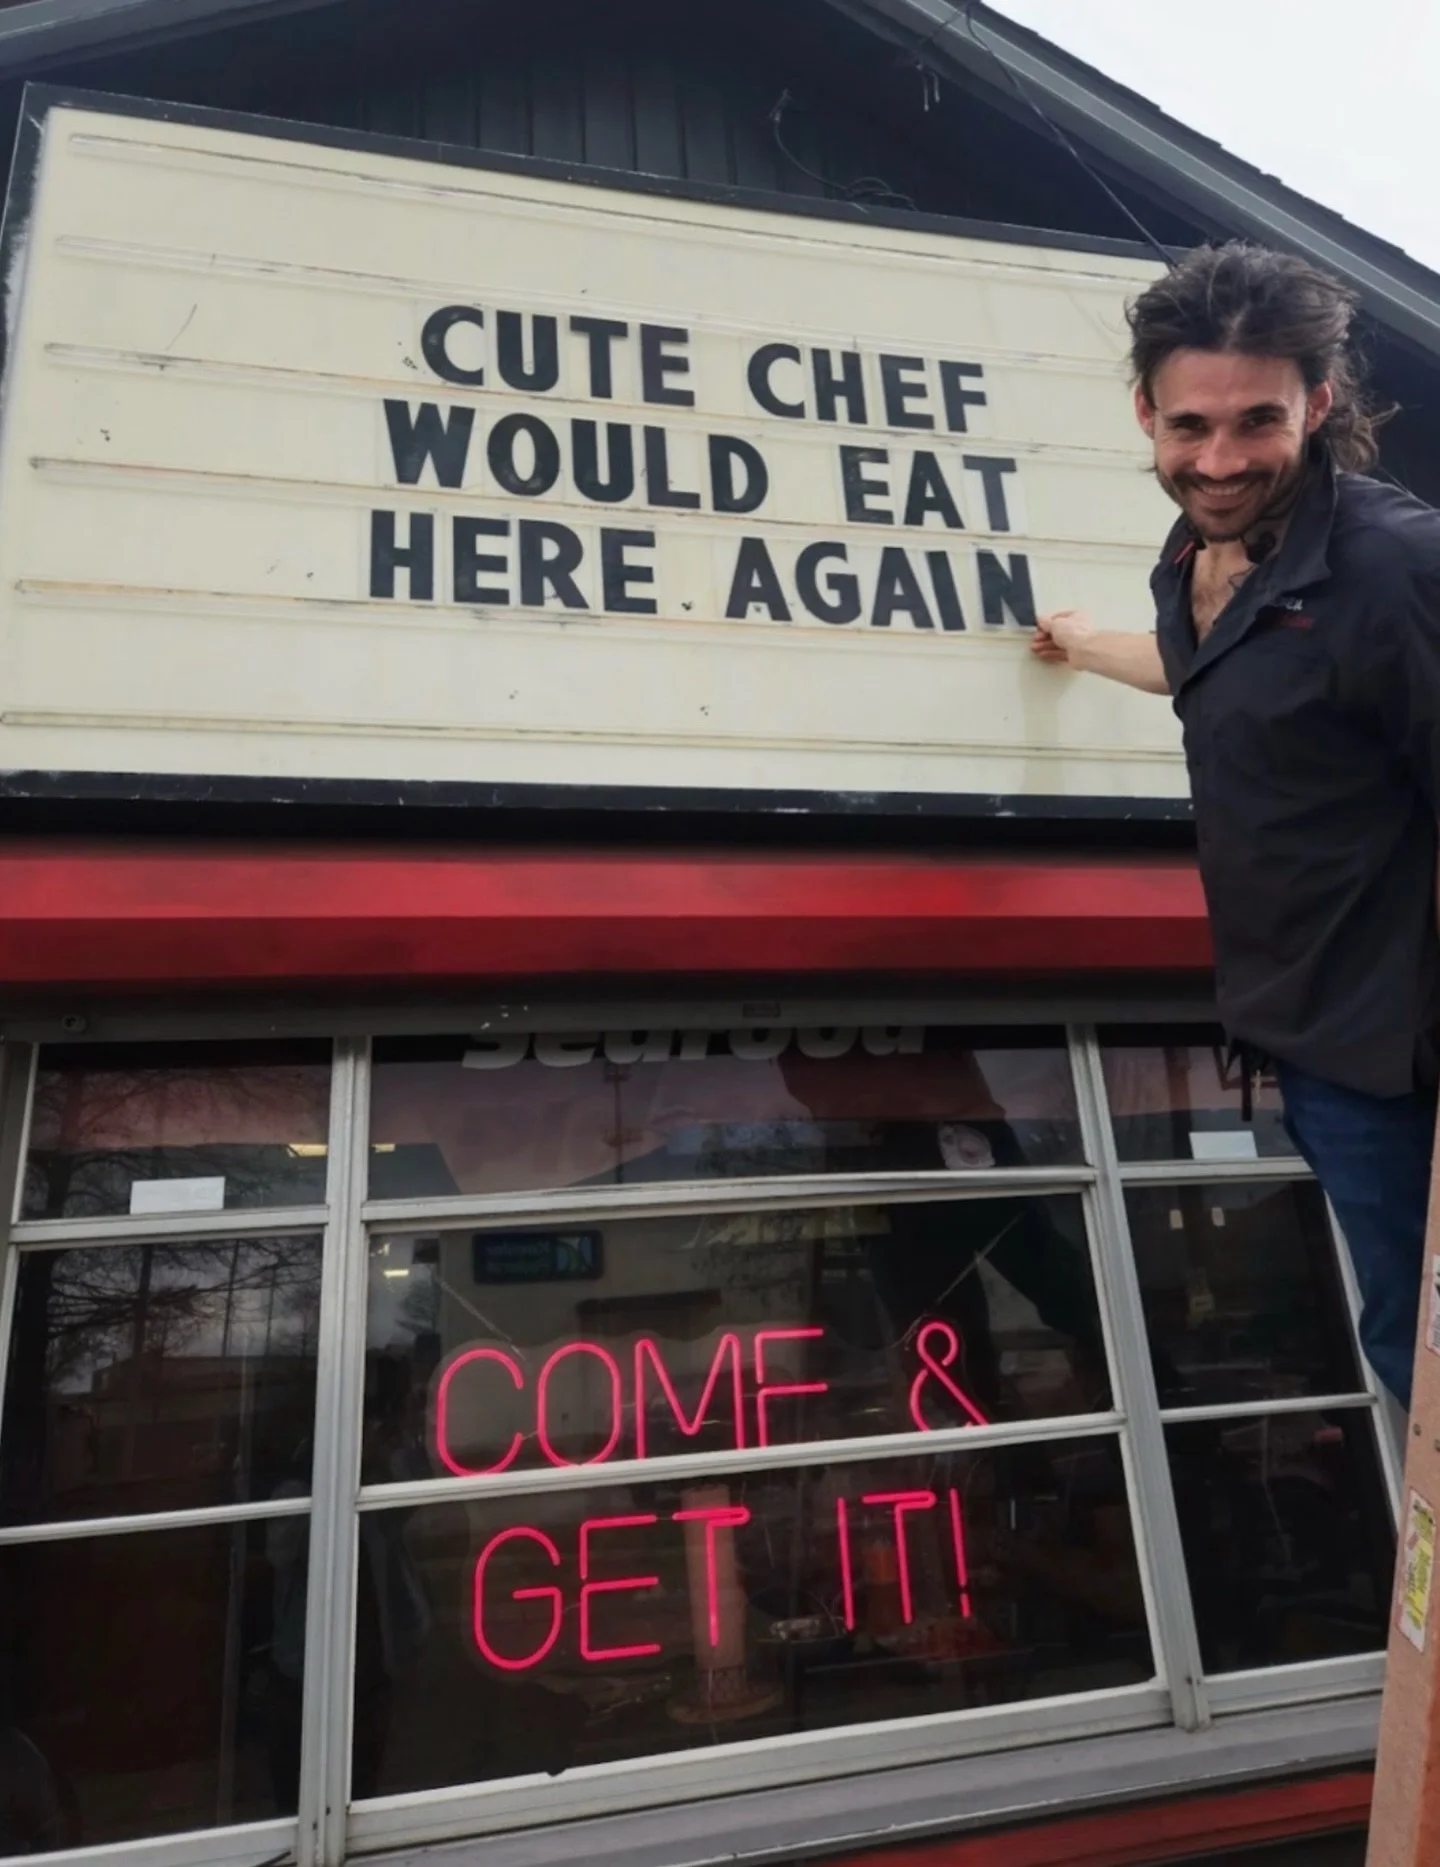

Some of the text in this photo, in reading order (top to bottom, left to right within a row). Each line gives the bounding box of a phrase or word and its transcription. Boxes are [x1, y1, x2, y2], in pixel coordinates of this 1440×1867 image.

[420, 304, 987, 433] CUTE CHEF
[383, 397, 1018, 532] WOULD EAT
[369, 508, 1039, 631] HERE AGAIN
[436, 1321, 989, 1478] COME &
[473, 1488, 971, 1669] GET IT!
